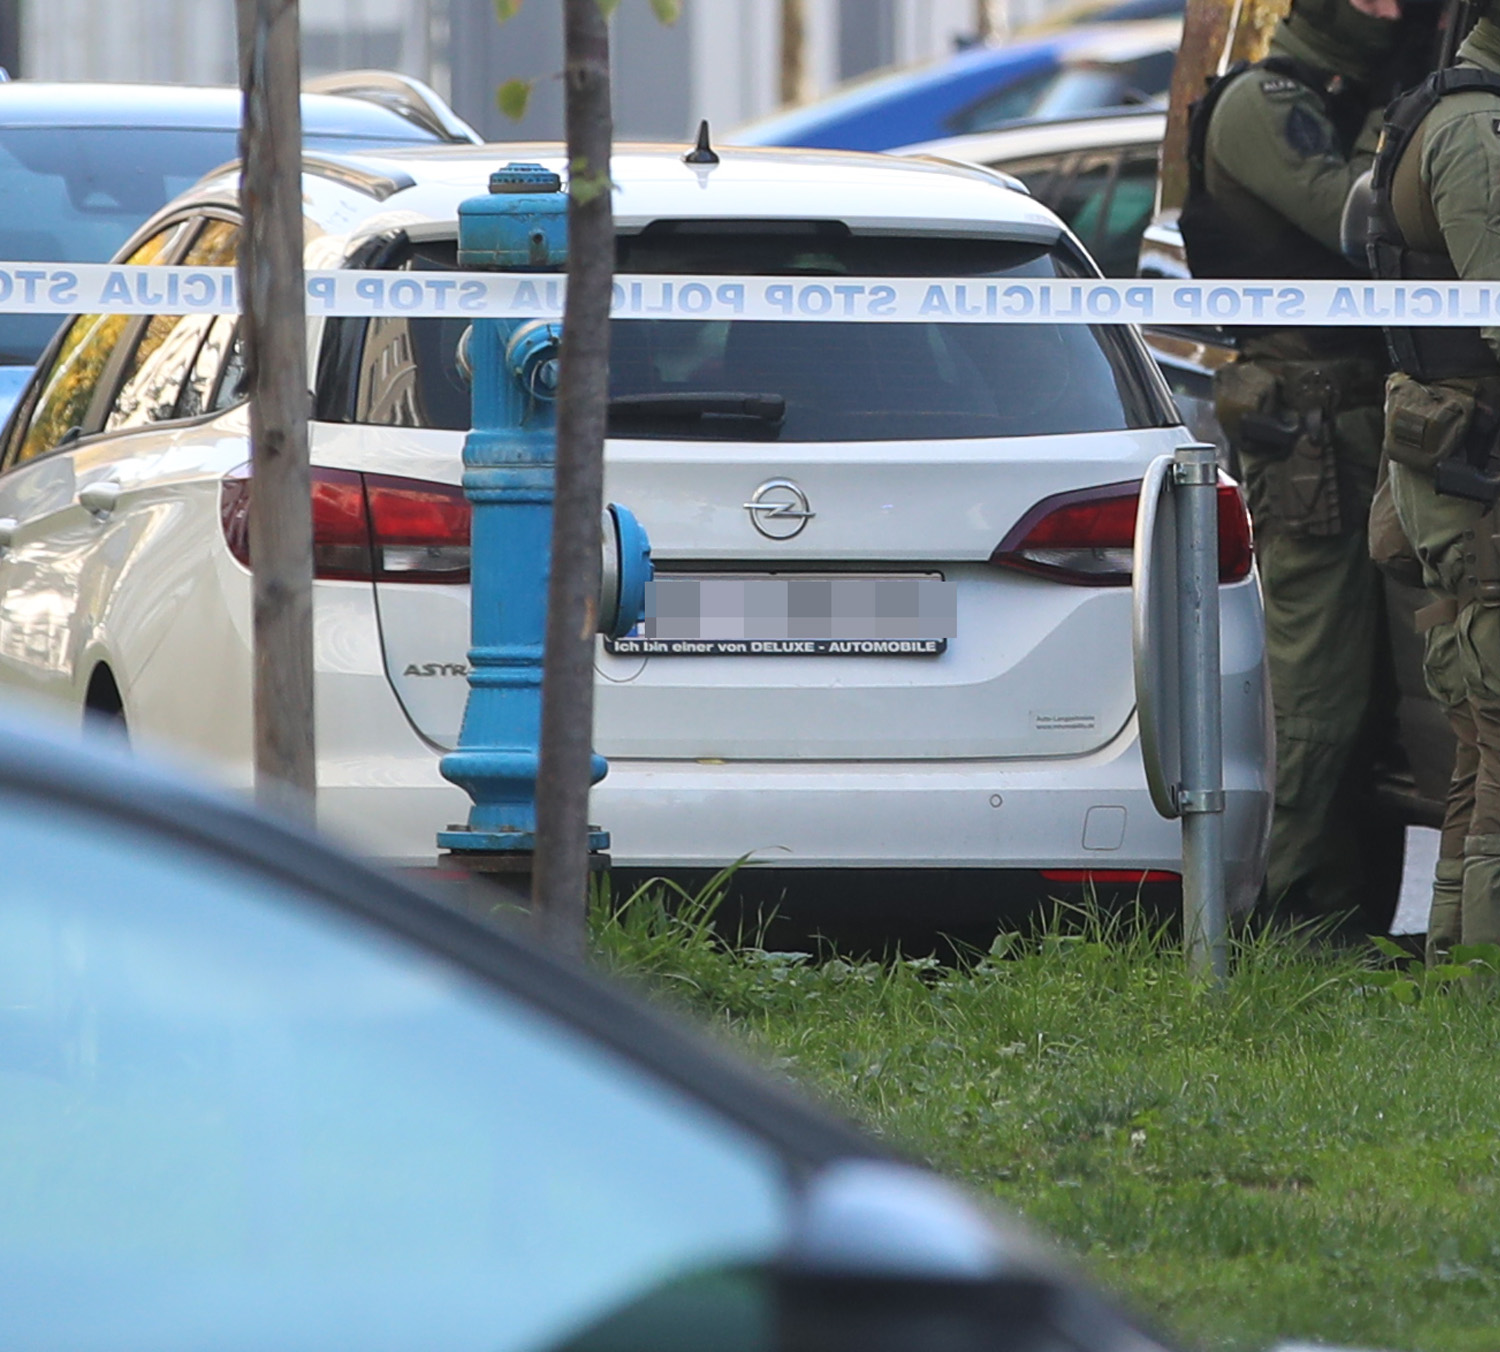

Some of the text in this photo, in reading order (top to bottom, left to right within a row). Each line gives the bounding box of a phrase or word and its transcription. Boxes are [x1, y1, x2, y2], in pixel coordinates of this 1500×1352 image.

[614, 641, 640, 653] Ich
[643, 641, 669, 653] bin
[672, 641, 714, 653] einer
[717, 643, 748, 653] von
[751, 641, 815, 654] DELUXE
[828, 641, 937, 653] AUTOMOBILE
[403, 663, 475, 677] ASTR
